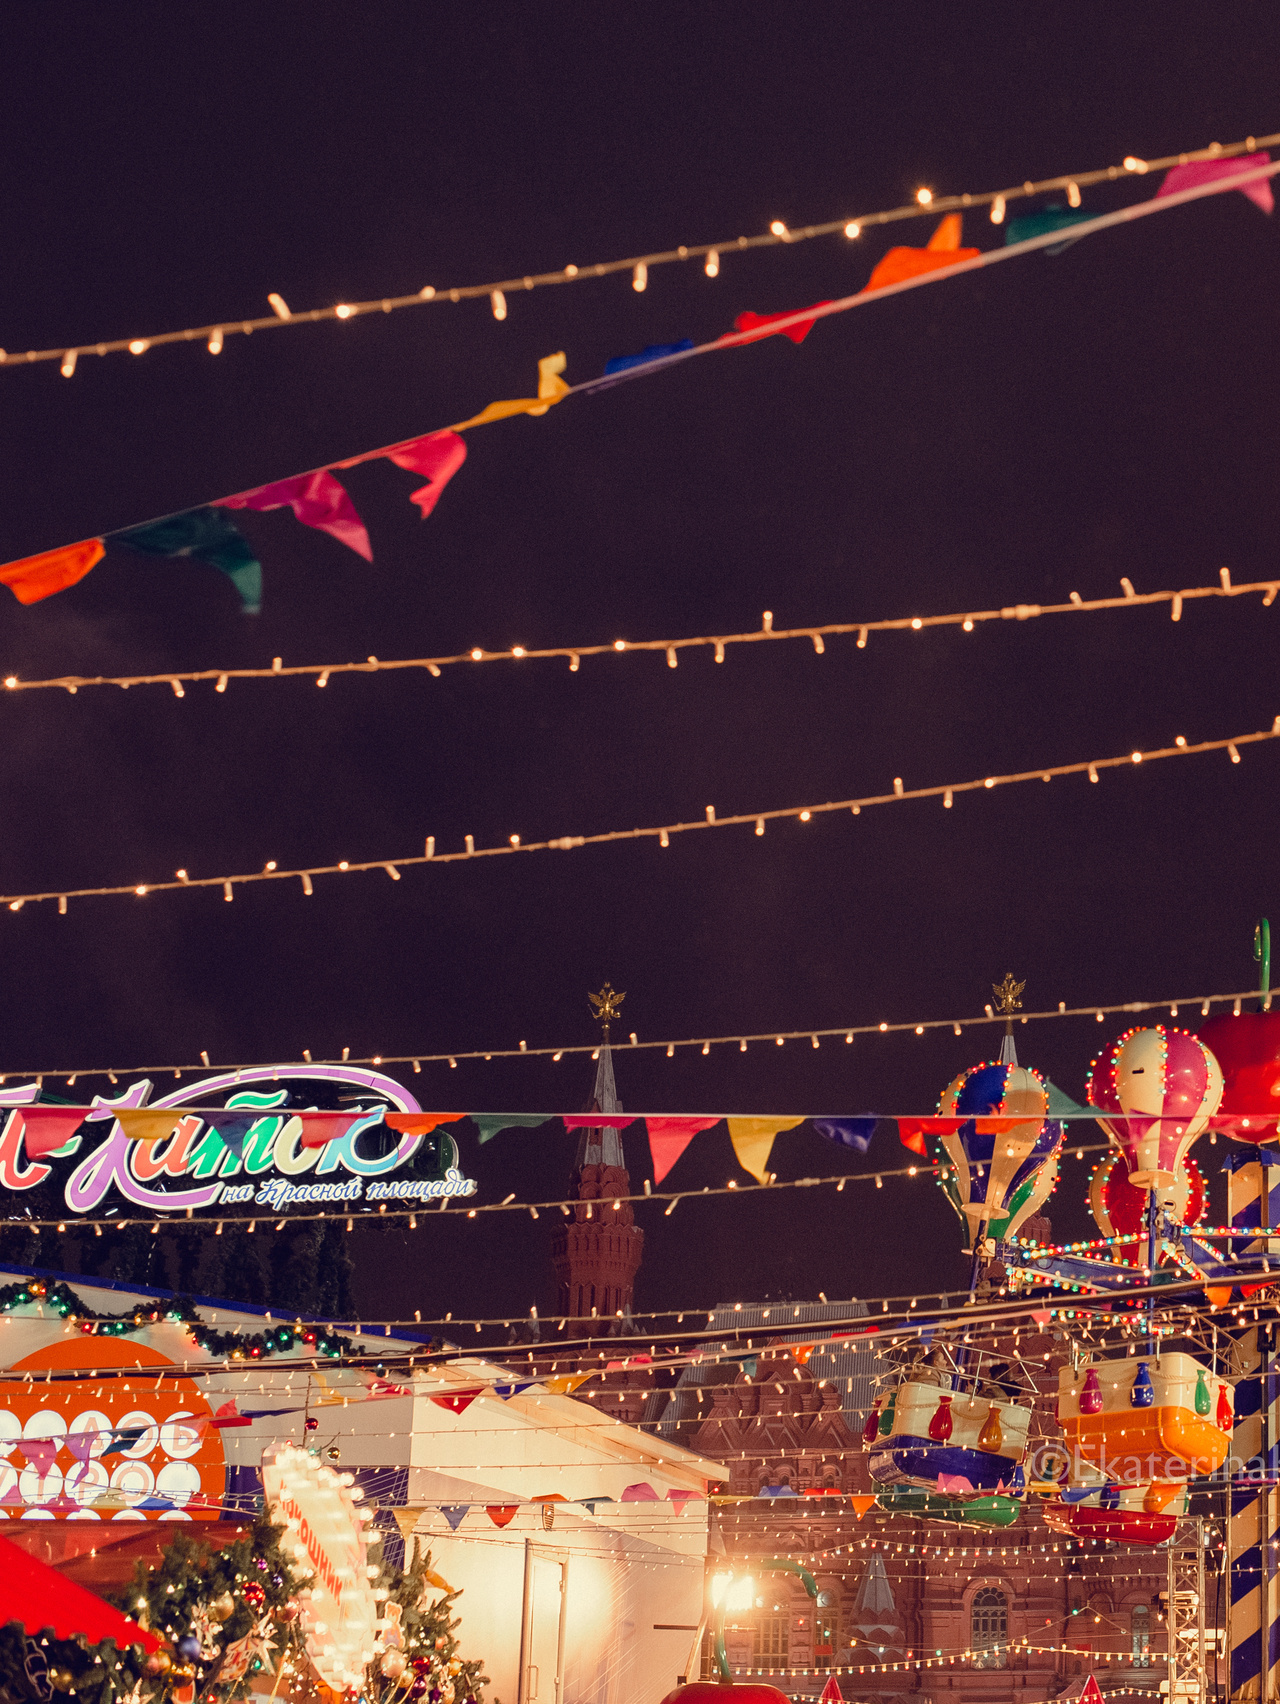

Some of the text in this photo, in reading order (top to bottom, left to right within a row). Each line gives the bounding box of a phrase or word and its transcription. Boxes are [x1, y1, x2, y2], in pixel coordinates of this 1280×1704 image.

[219, 1169, 475, 1211] на Красной площади
